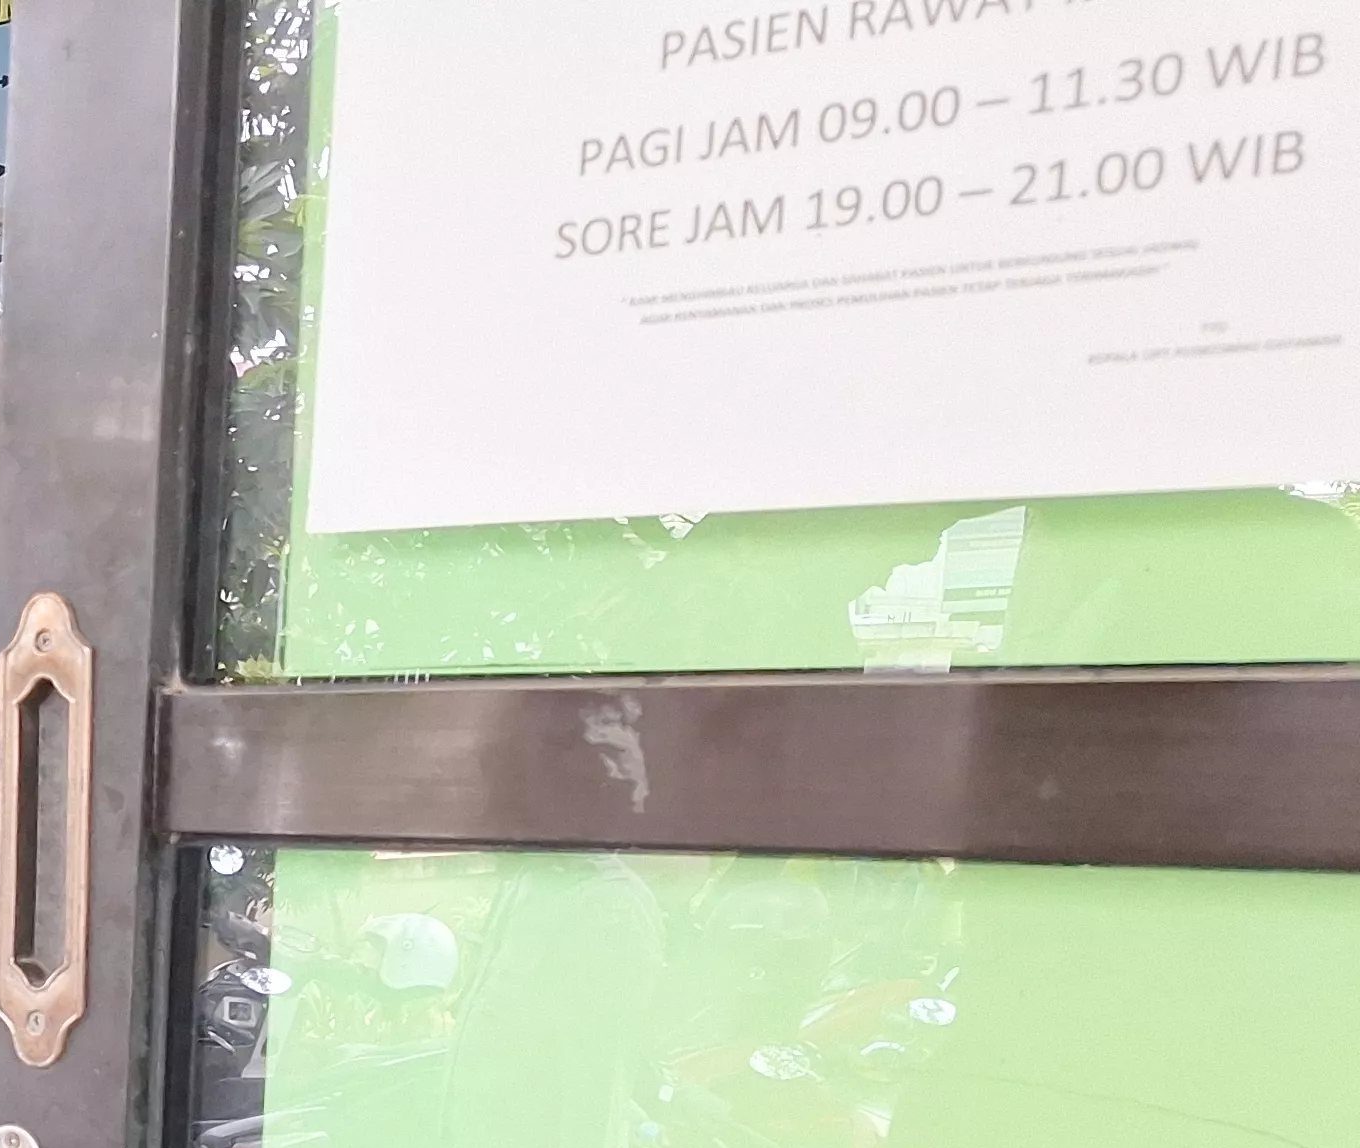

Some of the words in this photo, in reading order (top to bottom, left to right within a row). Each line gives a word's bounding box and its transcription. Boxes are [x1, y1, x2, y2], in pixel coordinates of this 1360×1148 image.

[660, 6, 829, 70] PASIEN
[849, 0, 1036, 40] RAW
[579, 125, 684, 176] PAGI
[698, 109, 801, 161] JAM
[818, 85, 961, 143] 09.00
[1029, 53, 1185, 115] 11.30
[1207, 32, 1326, 89] WIB
[554, 209, 672, 260] SORE
[684, 194, 785, 245] JAM
[806, 175, 944, 231] 19.00
[1009, 147, 1166, 206] 21.00
[1187, 130, 1305, 184] WIB
